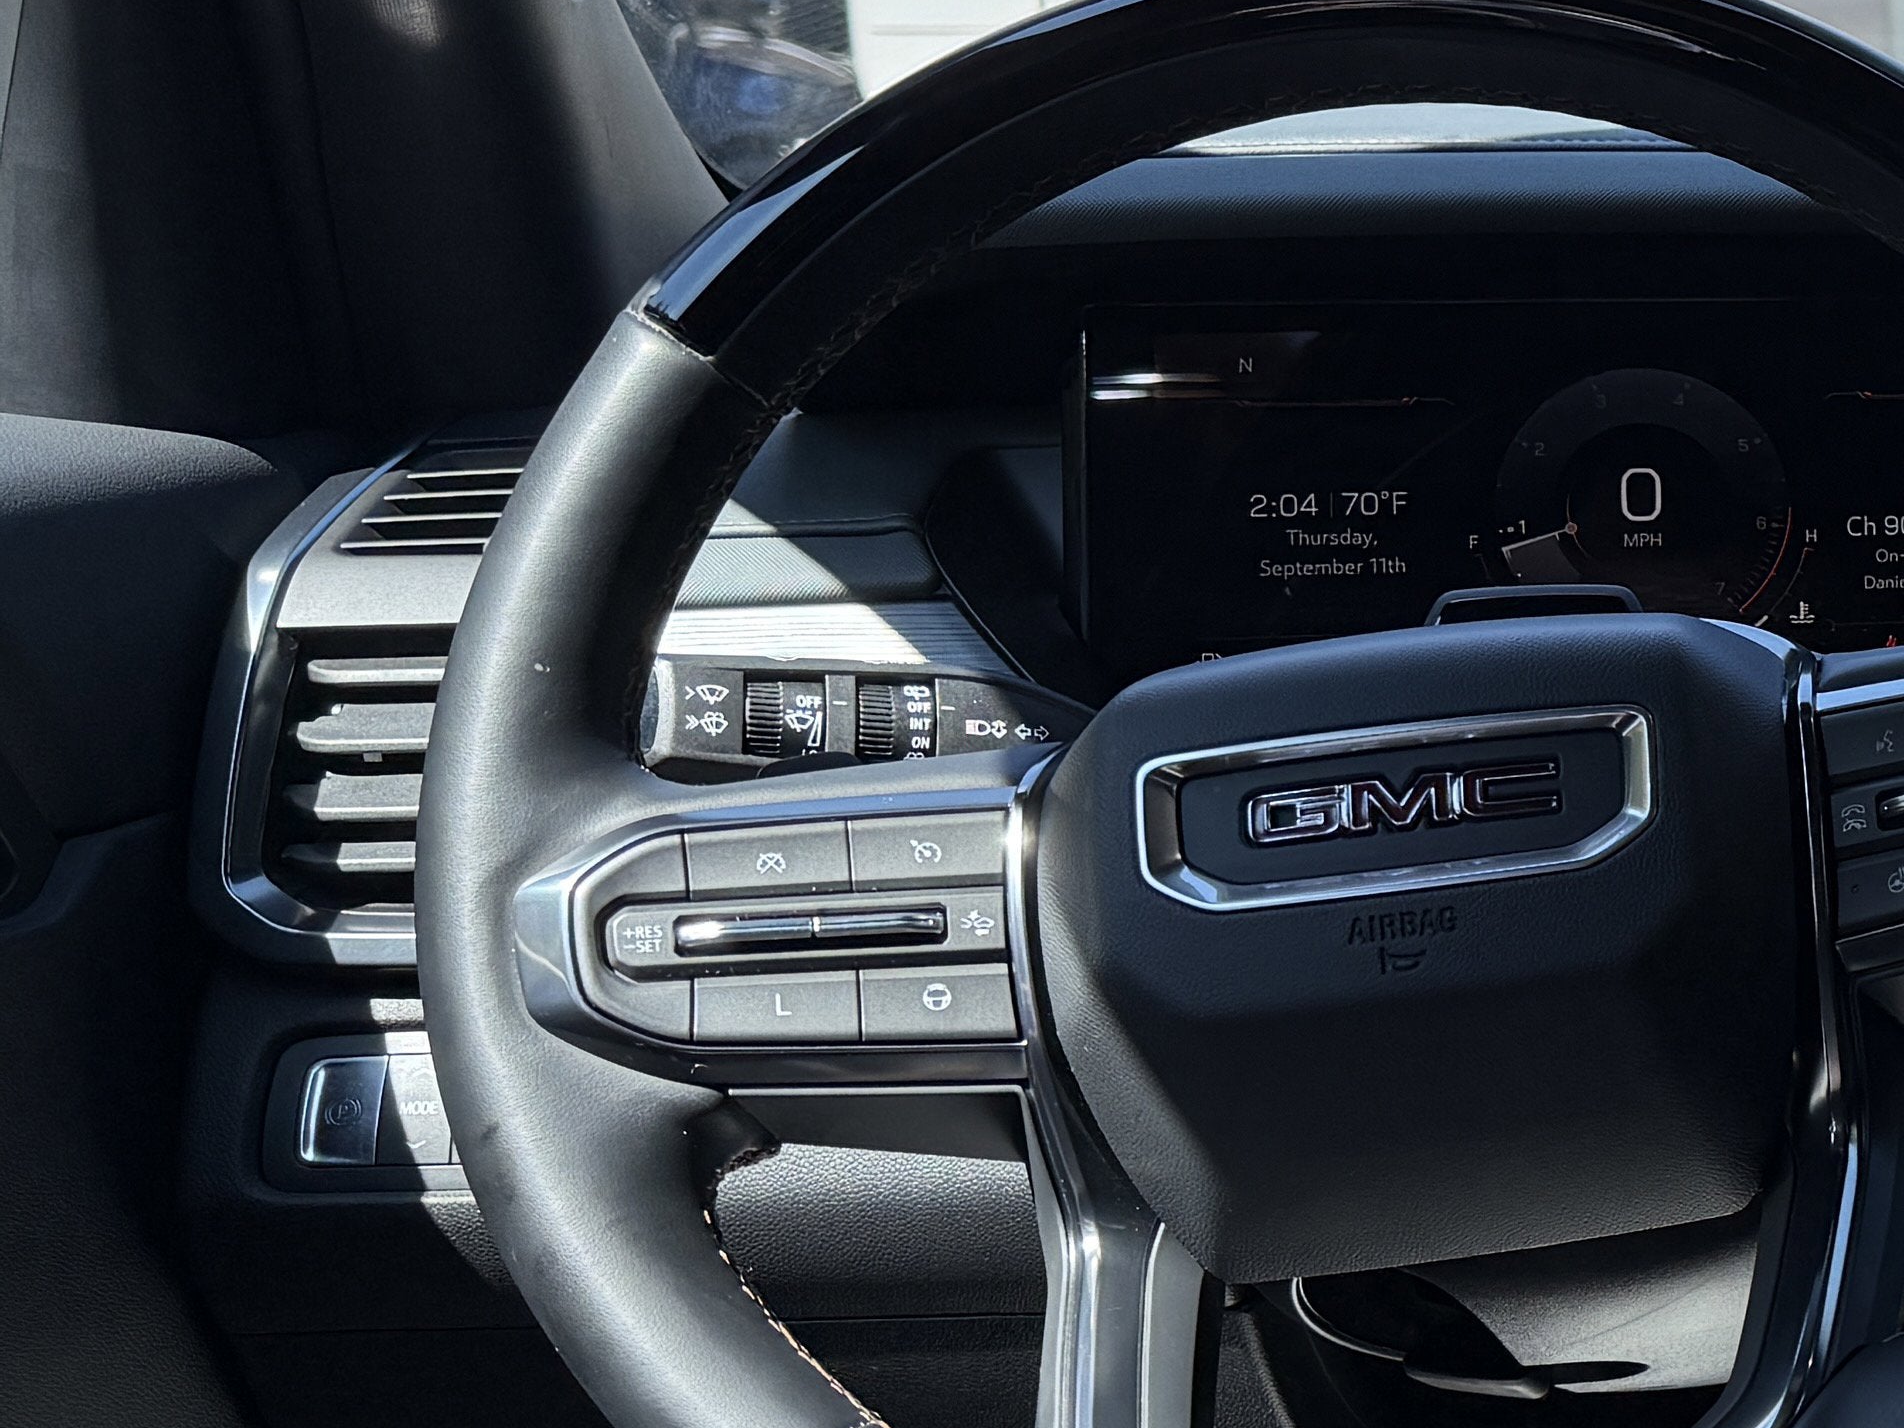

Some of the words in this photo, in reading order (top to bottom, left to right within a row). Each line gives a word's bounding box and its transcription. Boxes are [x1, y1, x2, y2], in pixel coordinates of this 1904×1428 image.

[1238, 357, 1253, 373] N
[1620, 467, 1662, 522] 0
[1250, 493, 1319, 518] 2:04
[1340, 491, 1408, 516] 70°F
[1847, 515, 1877, 536] Ch
[1285, 527, 1378, 549] Thursday,
[1469, 535, 1479, 549] F
[1623, 533, 1662, 547] MPH
[1805, 529, 1817, 542] H
[1259, 558, 1364, 580] September
[1370, 557, 1407, 574] 11th
[796, 694, 823, 710] OFF
[907, 700, 932, 715] OFF
[909, 717, 932, 731] INT
[911, 736, 931, 750] ON
[1247, 759, 1562, 845] GMC
[1348, 905, 1457, 945] AIRBAG
[775, 993, 793, 1016] L
[400, 1101, 439, 1115] MODE
